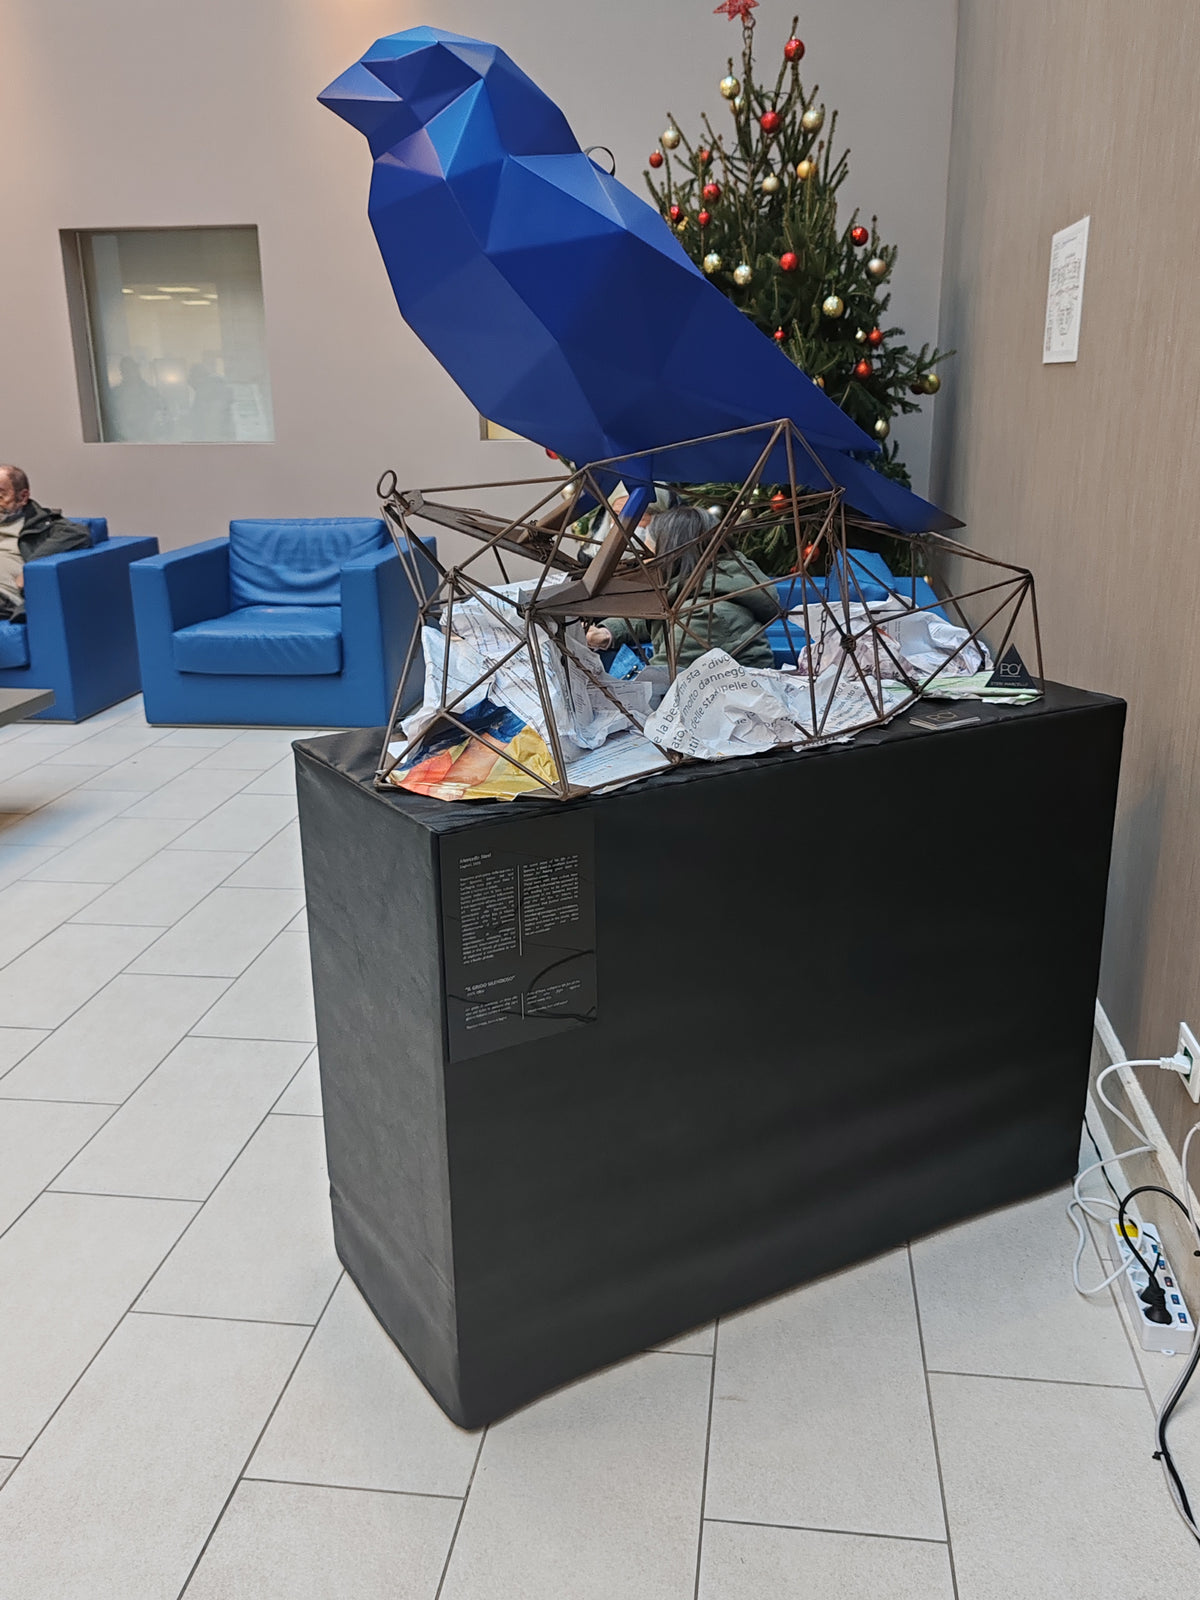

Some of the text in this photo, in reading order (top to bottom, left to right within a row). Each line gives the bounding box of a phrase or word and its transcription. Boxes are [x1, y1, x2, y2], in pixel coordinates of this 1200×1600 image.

[656, 724, 669, 735] la
[686, 668, 701, 683] sta
[681, 689, 699, 718] molto
[690, 706, 705, 729] delle
